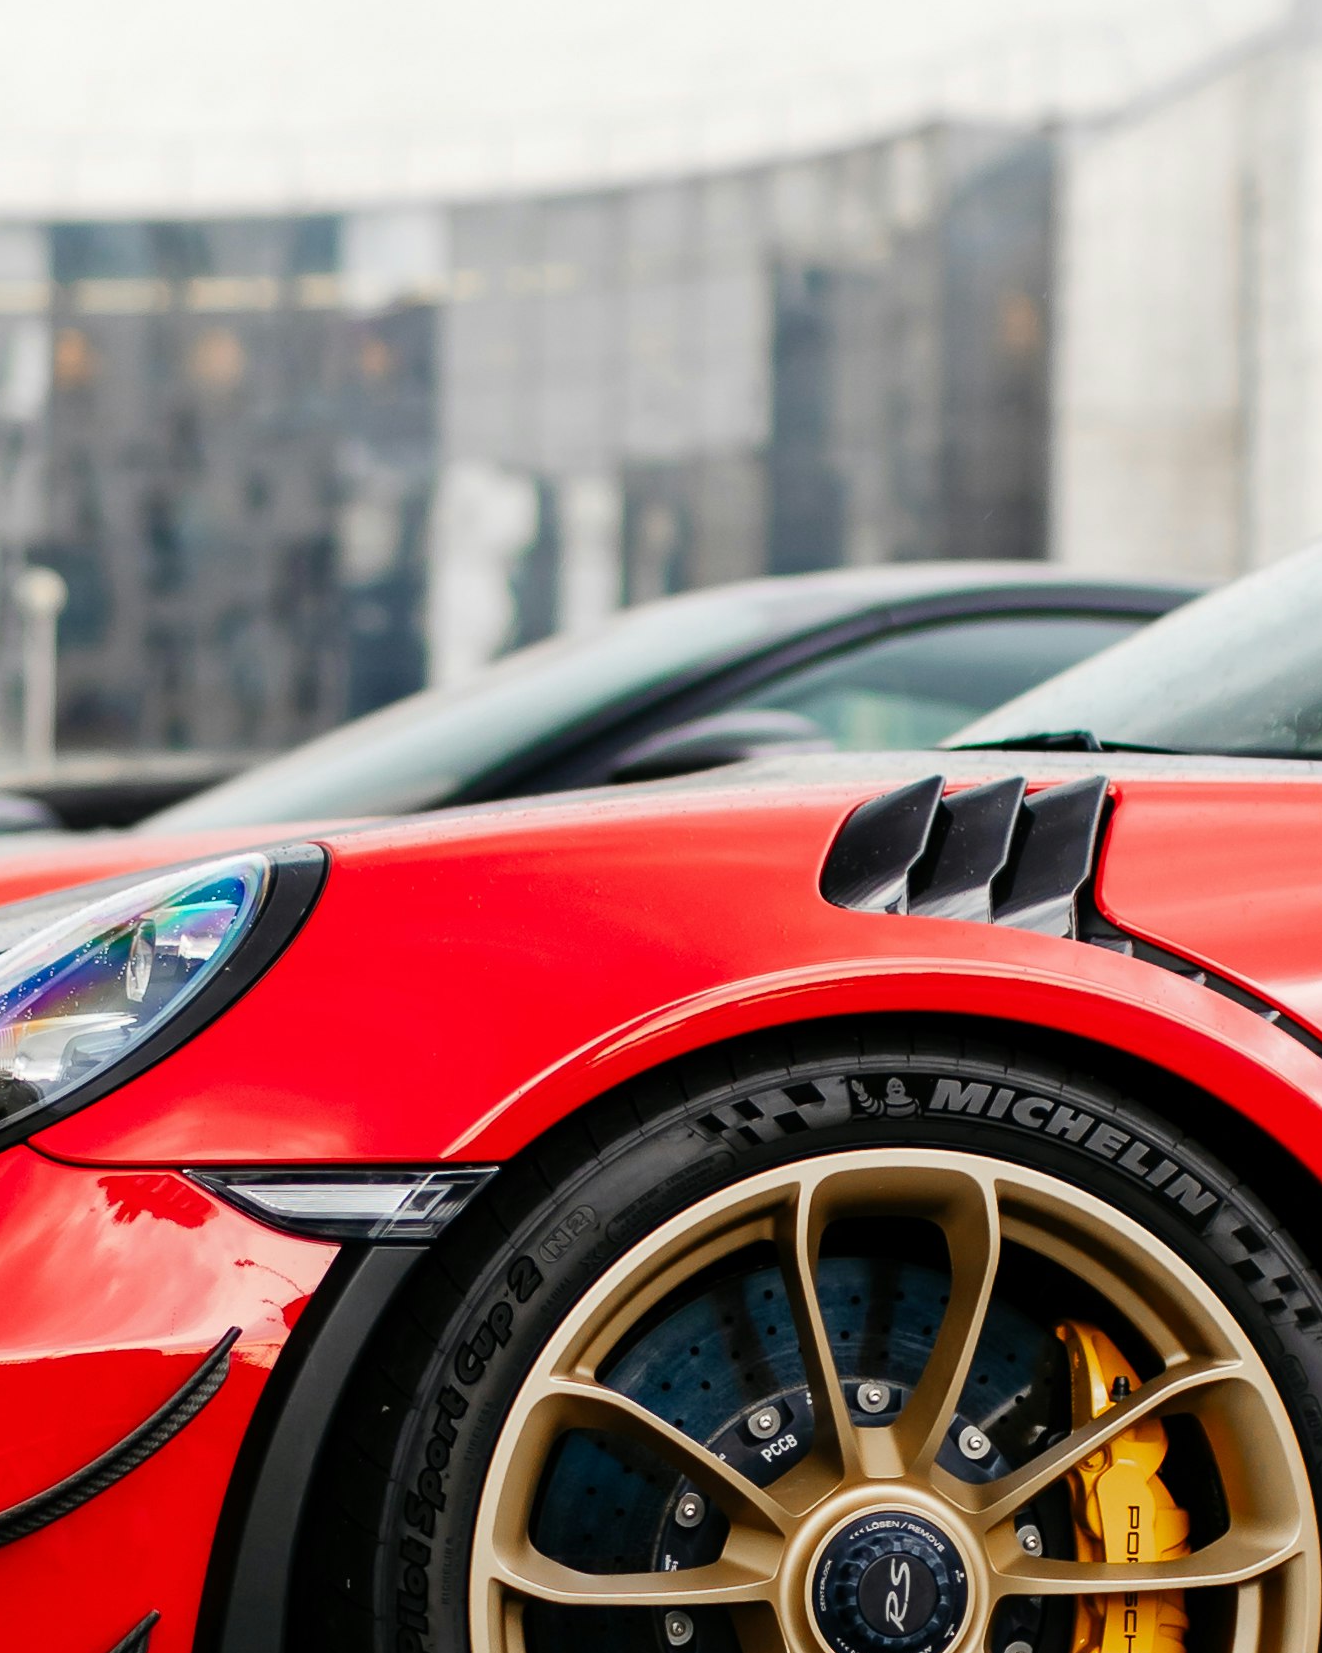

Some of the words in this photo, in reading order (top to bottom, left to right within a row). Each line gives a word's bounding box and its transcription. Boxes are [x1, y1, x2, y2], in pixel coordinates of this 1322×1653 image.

[928, 1078, 1218, 1216] MICHELIN
[404, 1383, 469, 1539] Sport
[454, 1301, 514, 1385] Cup
[507, 1255, 544, 1303] 2
[760, 1433, 799, 1463] PCCB
[907, 1522, 946, 1553] REMOVE
[885, 1557, 911, 1633] RS
